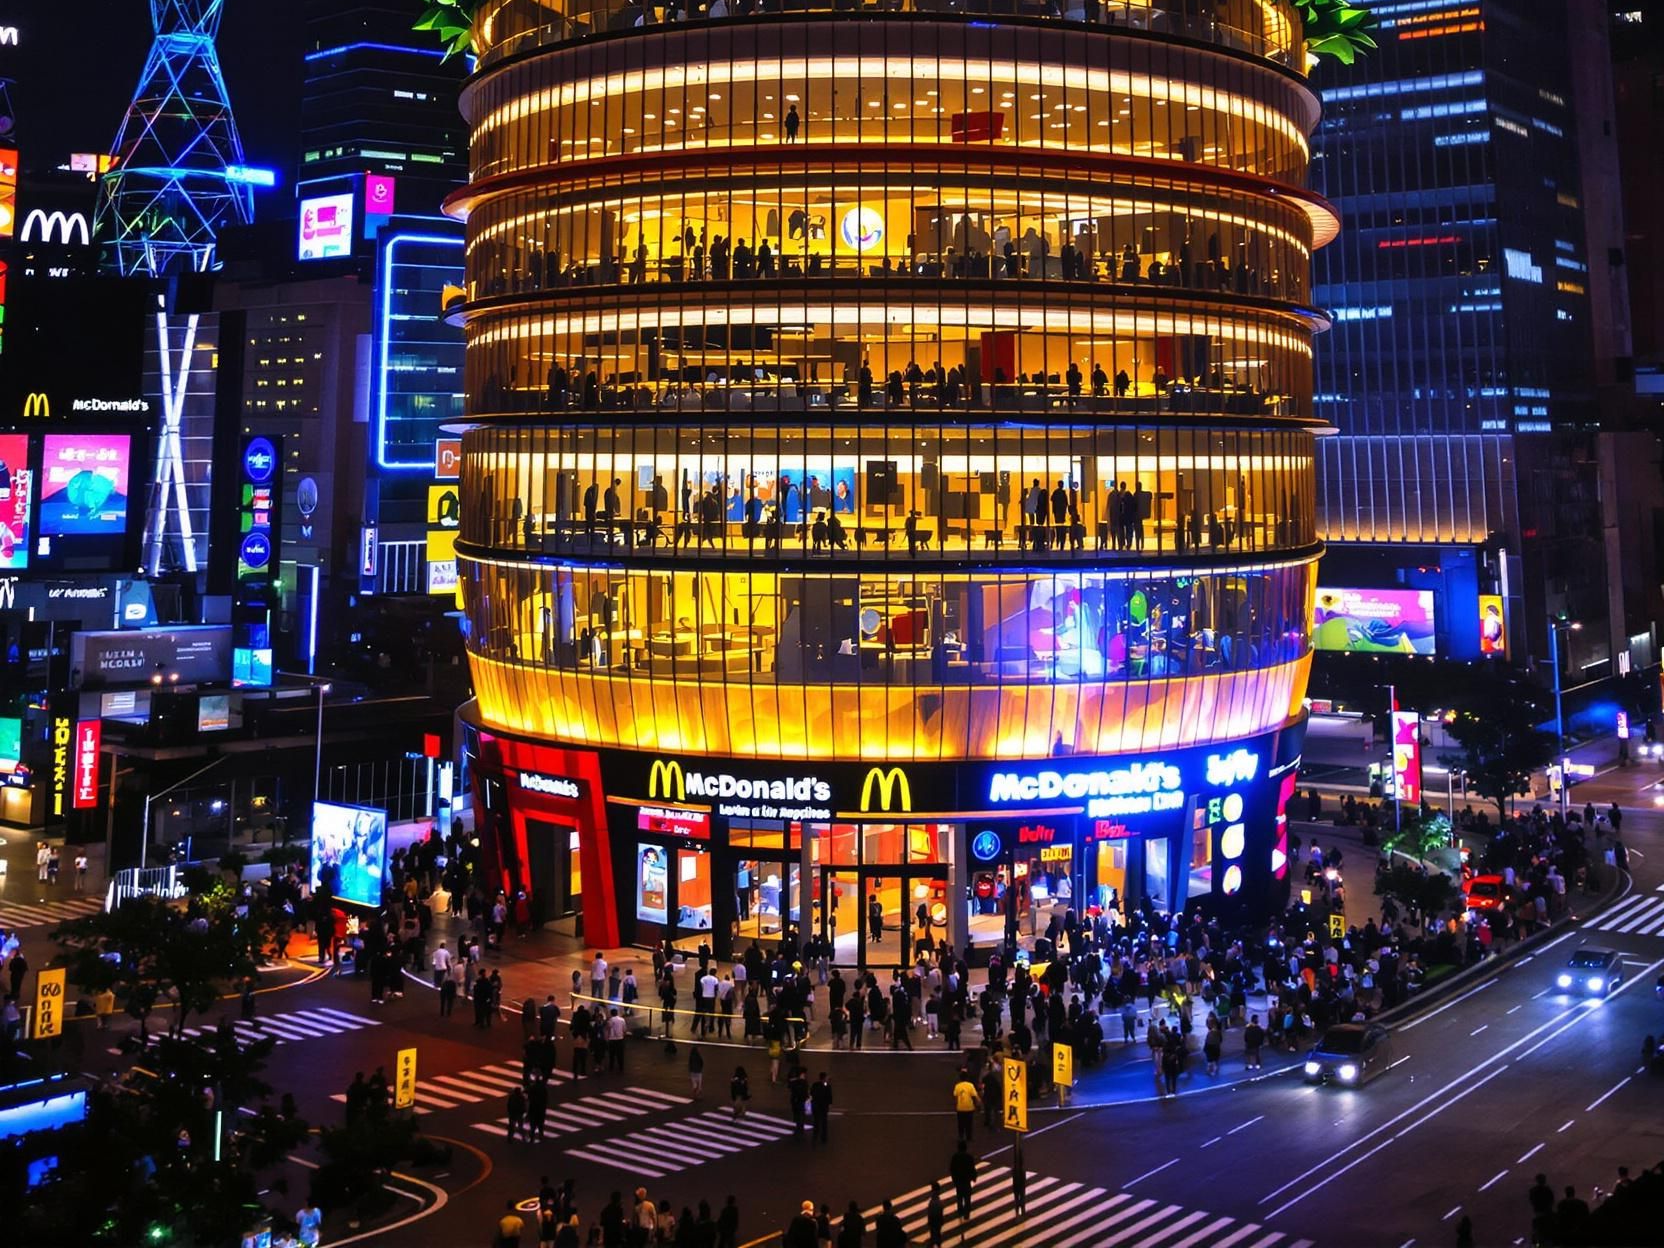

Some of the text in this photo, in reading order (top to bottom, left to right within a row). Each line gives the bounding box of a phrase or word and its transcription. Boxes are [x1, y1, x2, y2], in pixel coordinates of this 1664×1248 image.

[24, 393, 50, 416] M
[649, 760, 831, 801] M McDonald's
[860, 767, 911, 812] M
